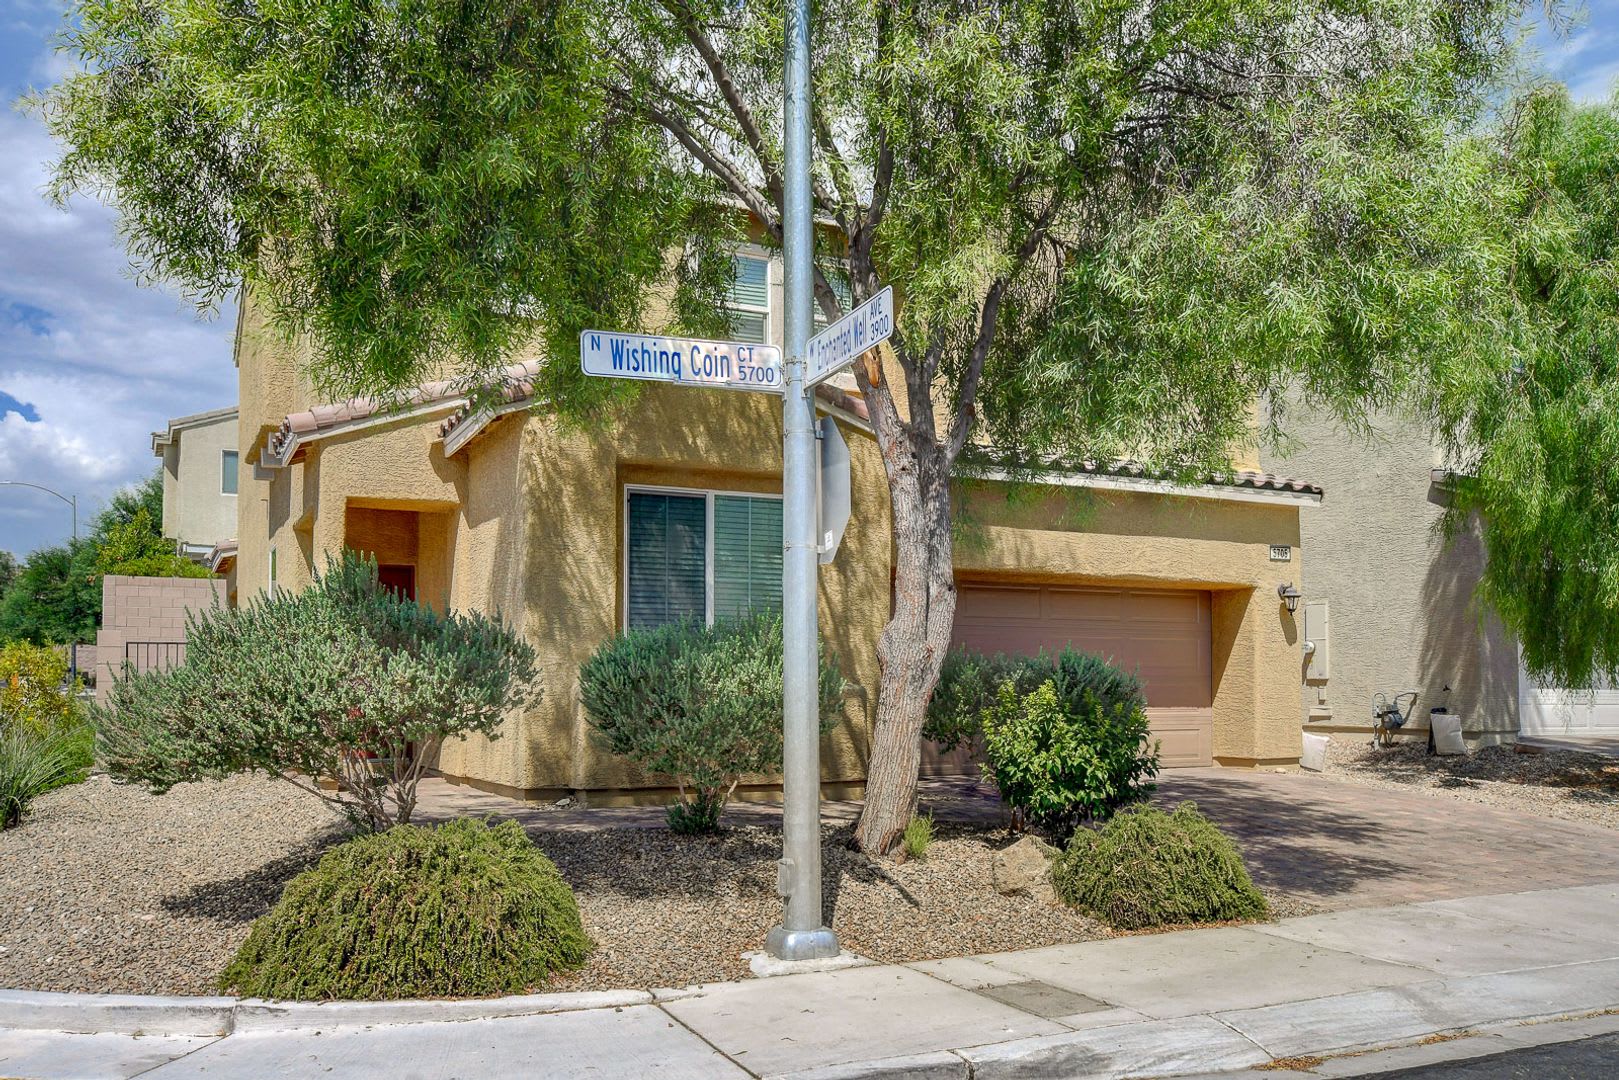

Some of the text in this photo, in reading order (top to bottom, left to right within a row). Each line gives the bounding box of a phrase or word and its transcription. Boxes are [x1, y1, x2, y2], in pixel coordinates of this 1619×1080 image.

[869, 296, 883, 321] AVE
[852, 309, 868, 350] Well
[870, 314, 889, 341] 3900
[591, 335, 730, 380] N Wishing Coin
[737, 346, 755, 363] CT
[738, 365, 775, 383] 5700
